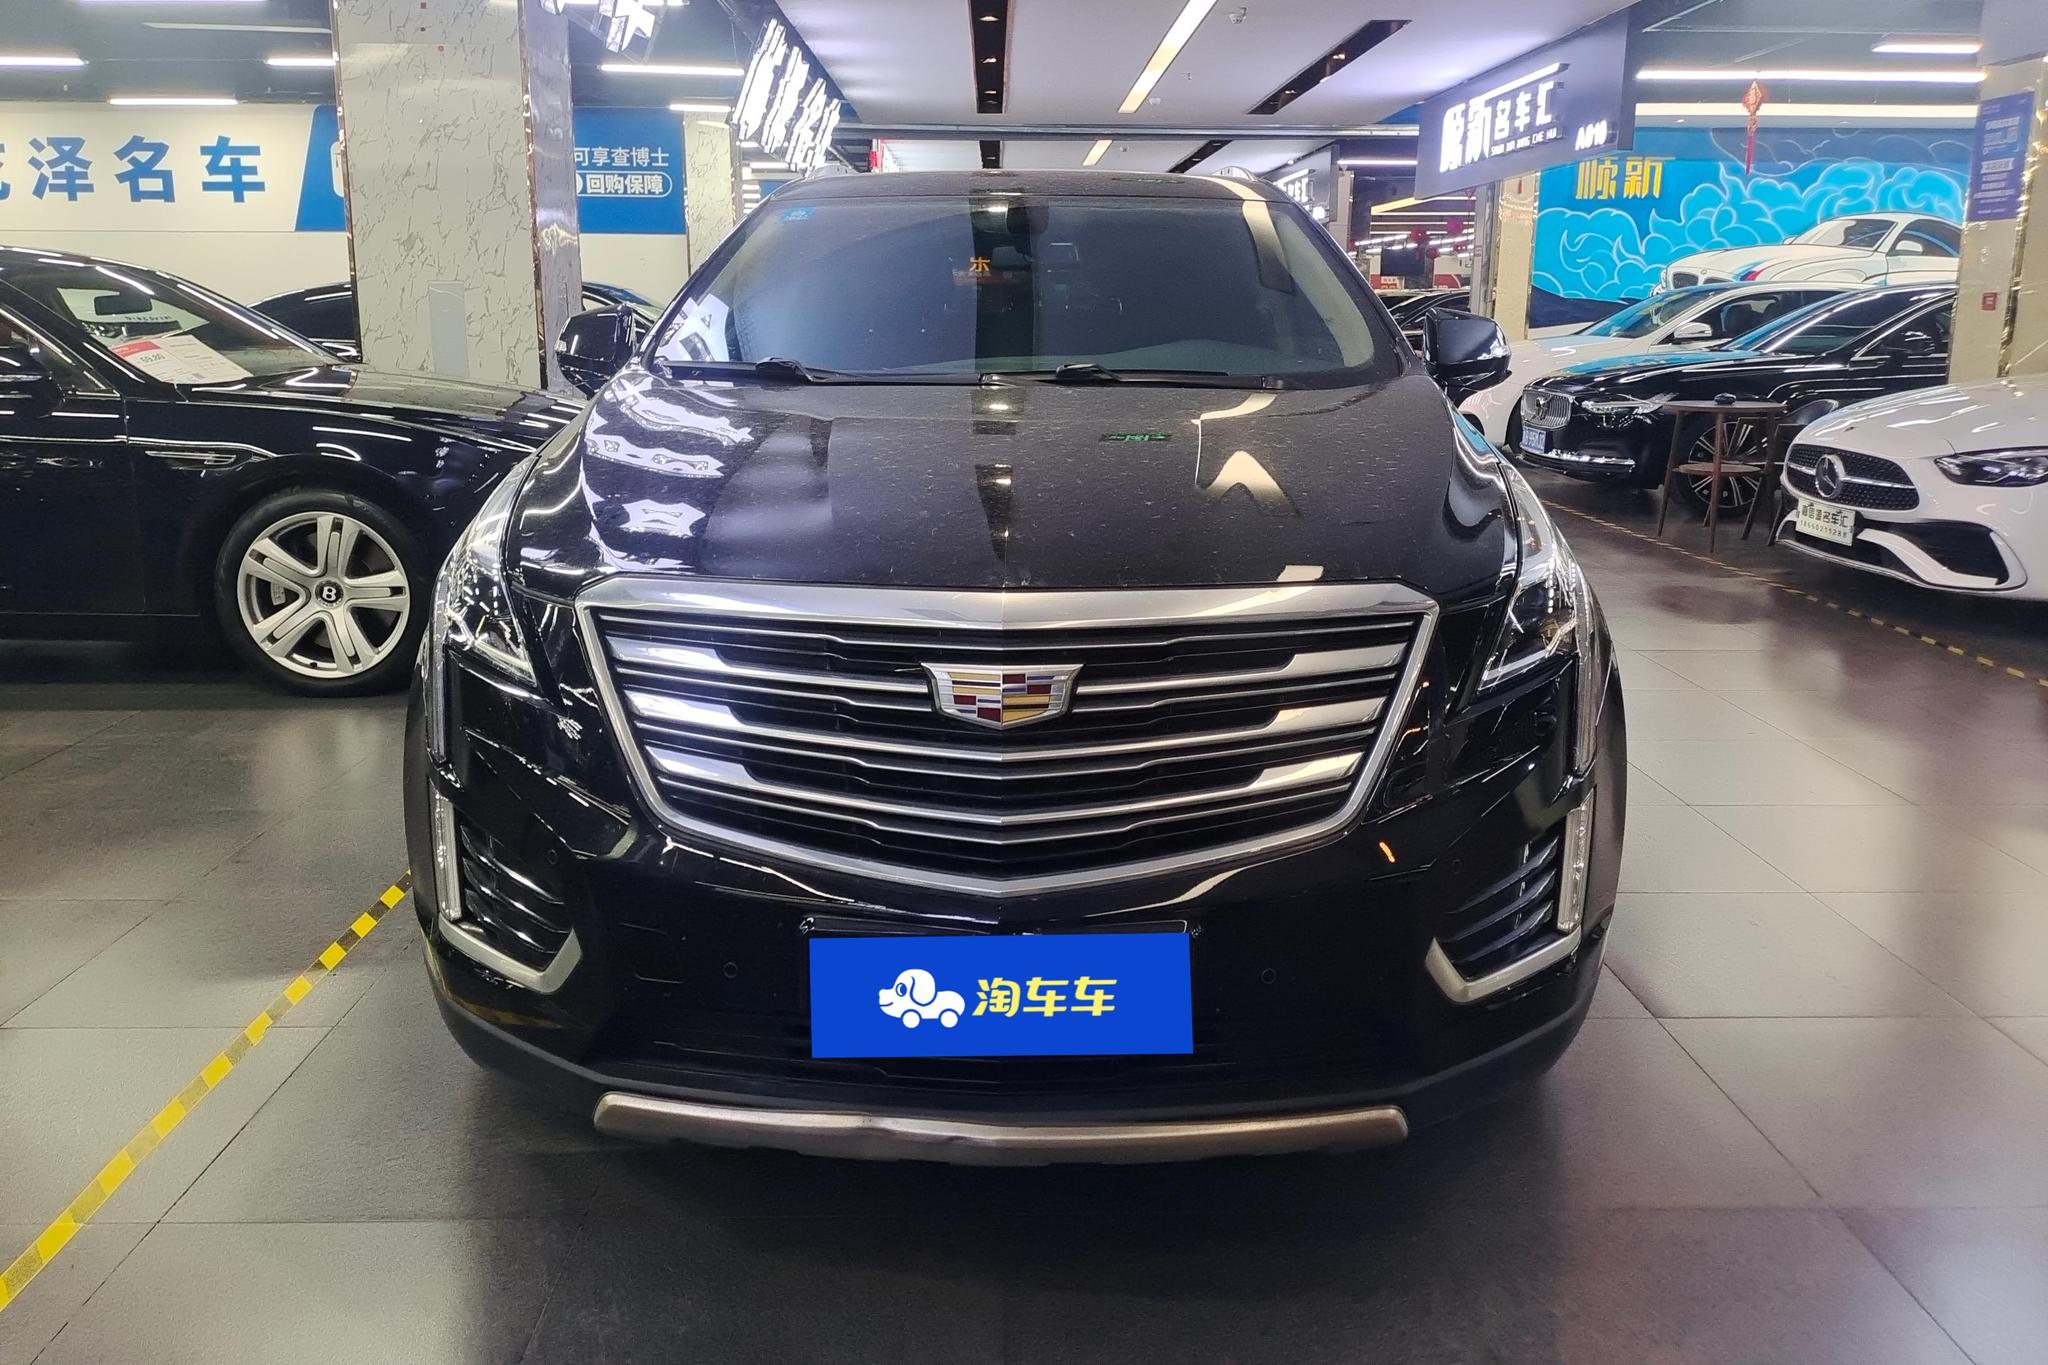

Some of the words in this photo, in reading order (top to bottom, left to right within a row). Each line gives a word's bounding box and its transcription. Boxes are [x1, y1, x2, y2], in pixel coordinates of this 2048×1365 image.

[574, 146, 670, 168] 可享查博士
[0, 135, 266, 203] 泽名车
[586, 174, 664, 195] 回购保障
